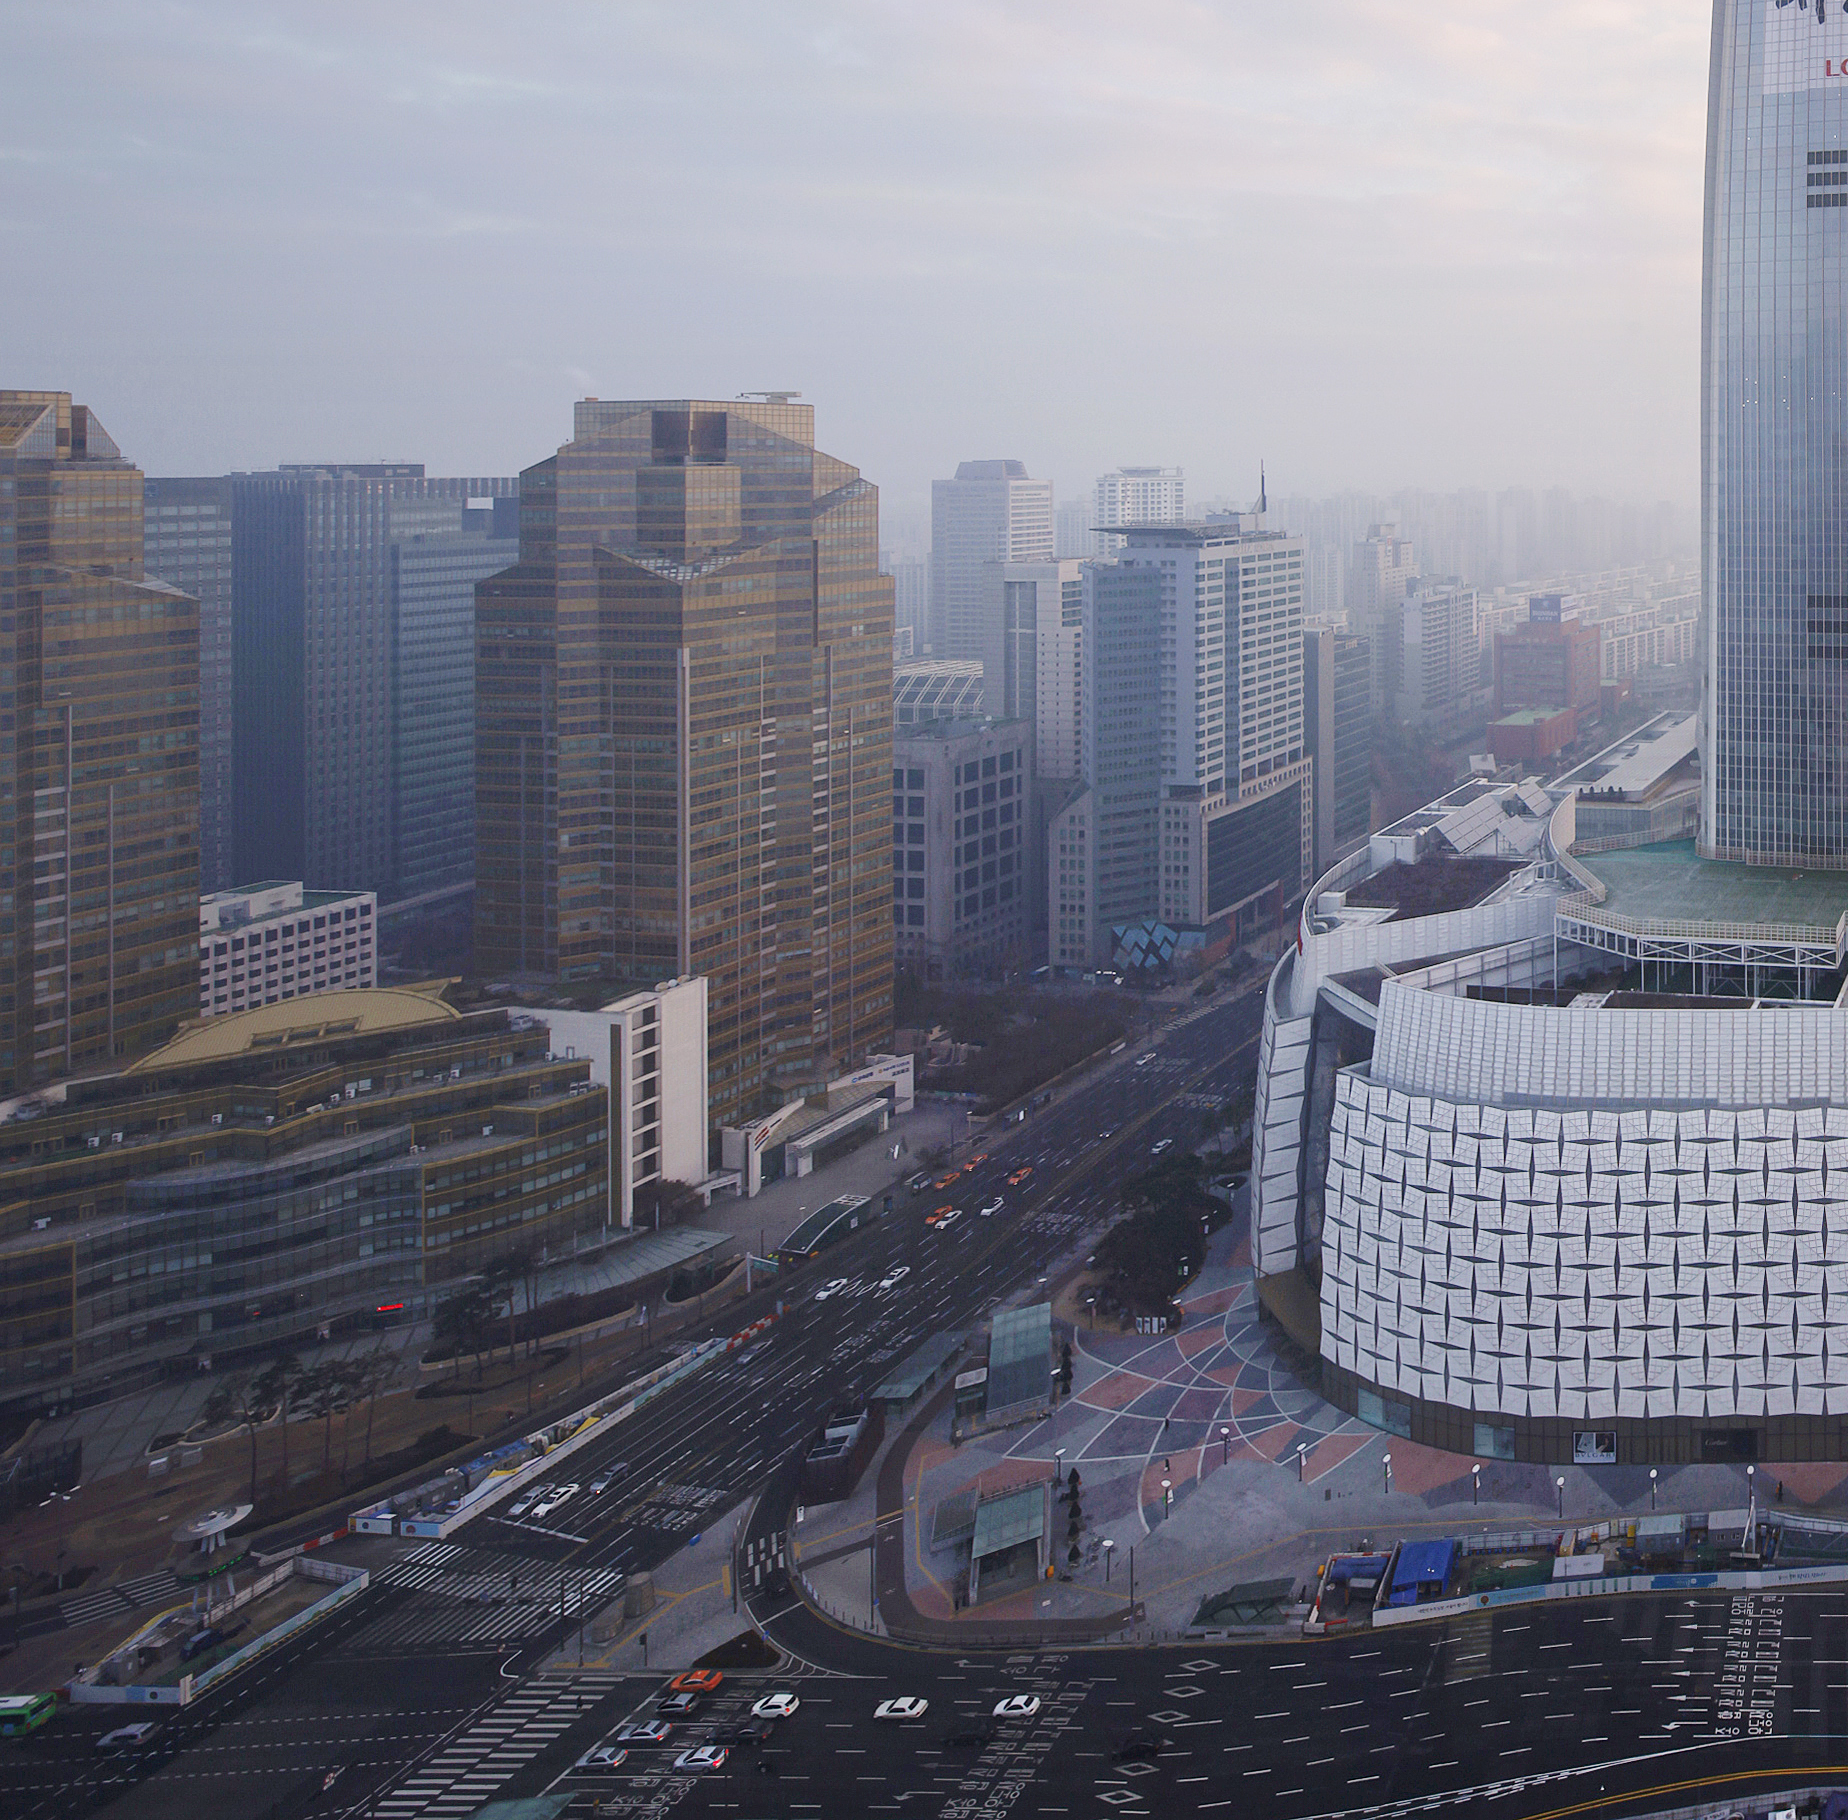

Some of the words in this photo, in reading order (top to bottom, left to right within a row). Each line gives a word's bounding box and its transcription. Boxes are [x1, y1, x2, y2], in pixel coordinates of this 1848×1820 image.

[1731, 1596, 1755, 1615] 올림픽
[1760, 1596, 1785, 1615] 공원
[1728, 1618, 1753, 1635] 잠실
[1725, 1641, 1750, 1658] 잠실
[1722, 1664, 1747, 1682] 잠실
[1718, 1688, 1745, 1707] 잠실
[1715, 1710, 1742, 1734] 종합
[1748, 1711, 1774, 1735] 운동장
[610, 1777, 662, 1804] 종합
[650, 1778, 698, 1805] 운동장
[944, 1781, 990, 1808] 종합
[984, 1782, 1026, 1808] 운동장
